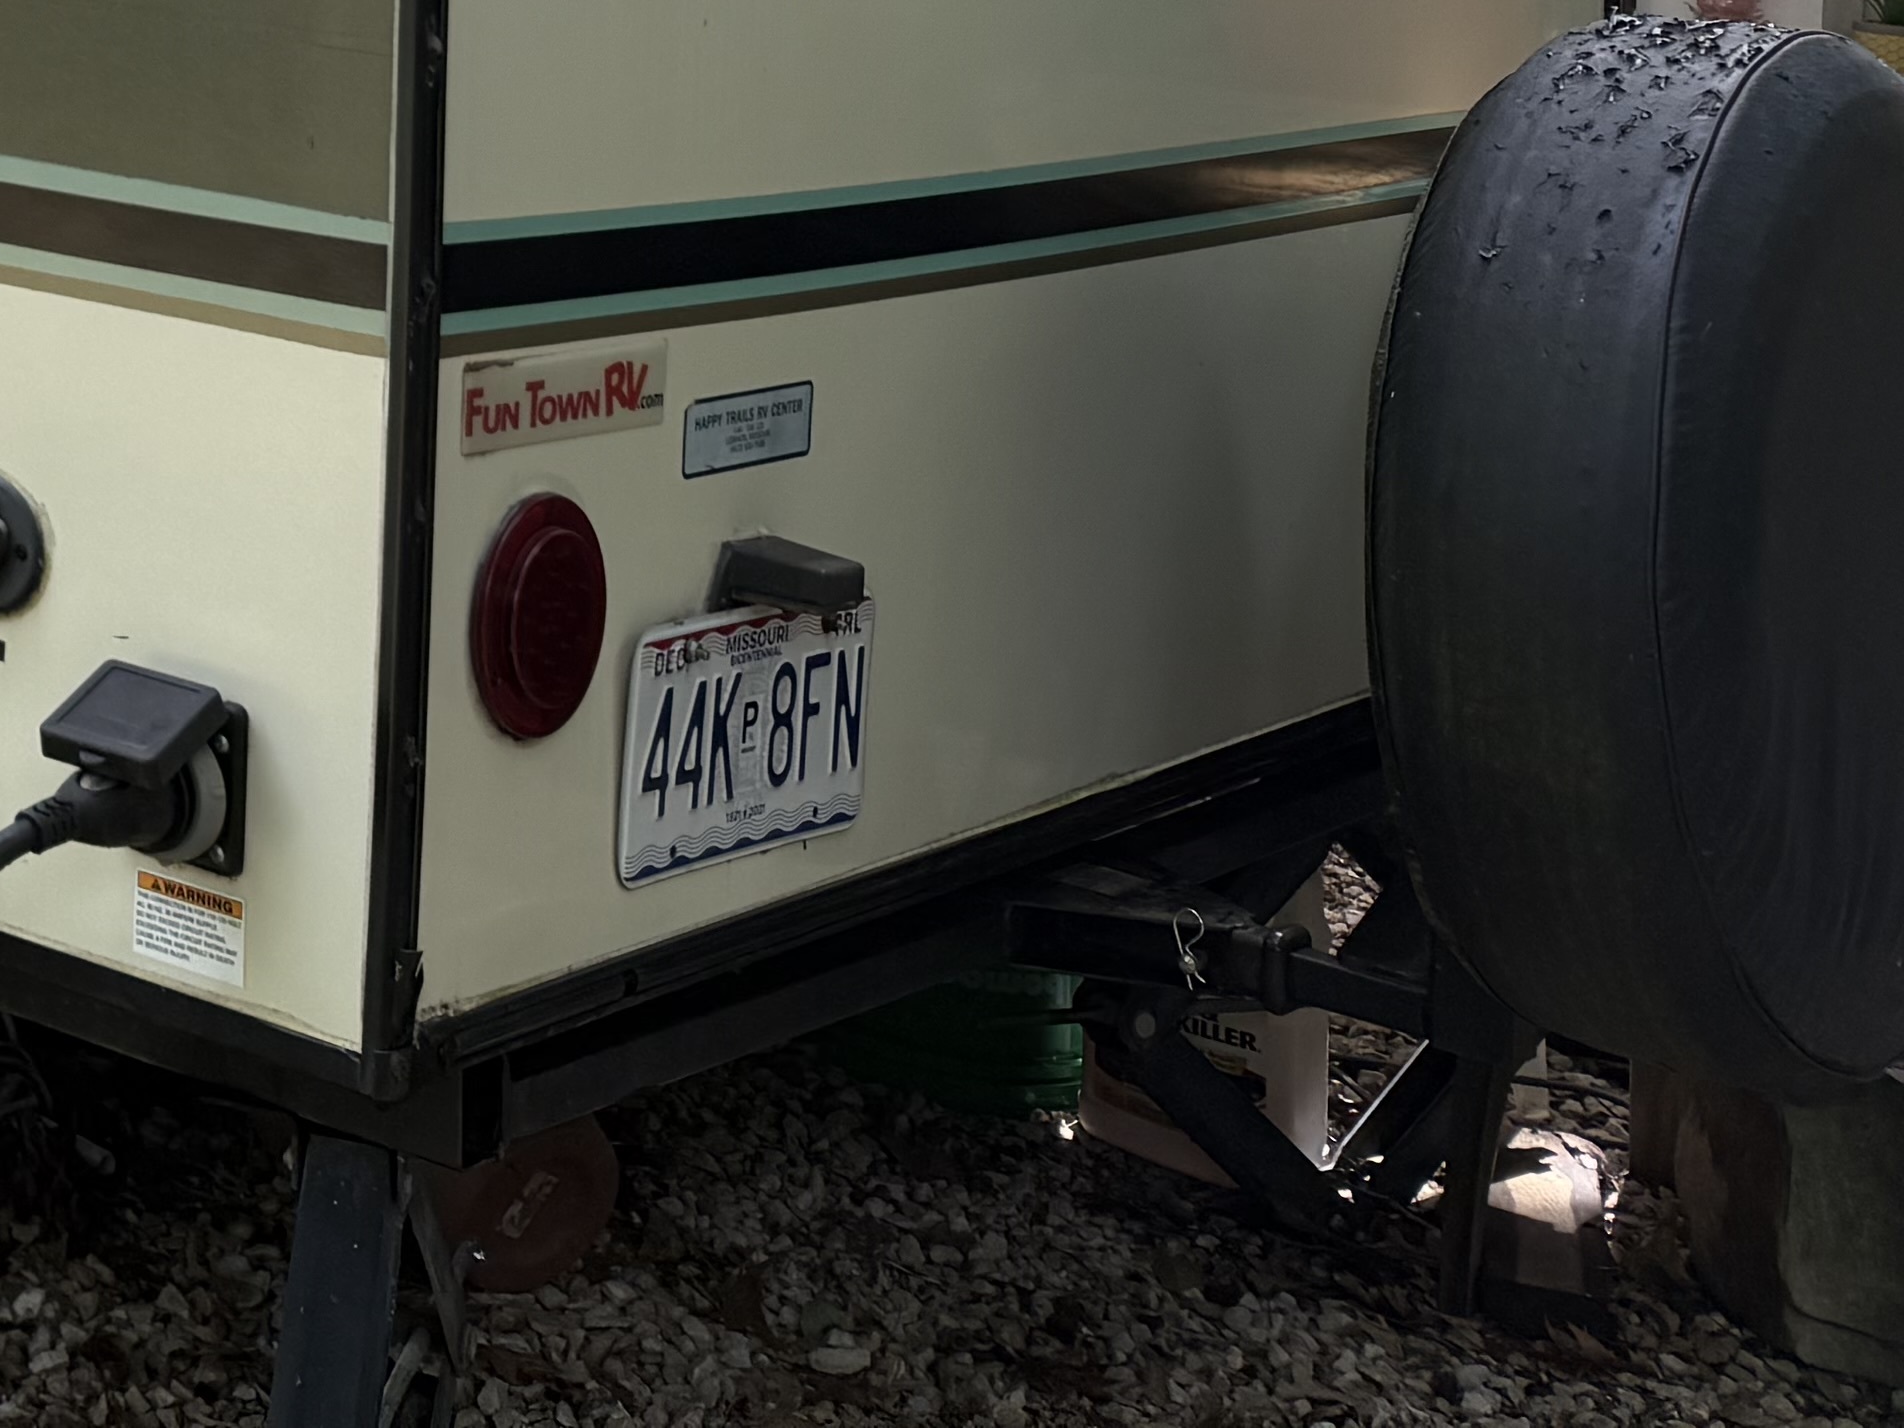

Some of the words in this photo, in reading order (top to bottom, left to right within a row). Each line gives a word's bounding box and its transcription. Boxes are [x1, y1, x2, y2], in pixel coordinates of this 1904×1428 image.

[465, 387, 520, 437] FUN
[525, 379, 600, 429] TOWN
[694, 413, 723, 432] HAPPY
[726, 406, 754, 425] TRAILS
[757, 404, 769, 420] RV
[771, 398, 803, 417] CENTER
[725, 624, 790, 655] MISSOURI
[641, 671, 743, 819] 44K
[742, 700, 759, 744] P
[767, 645, 865, 788] 8FN
[162, 881, 234, 914] WARNING
